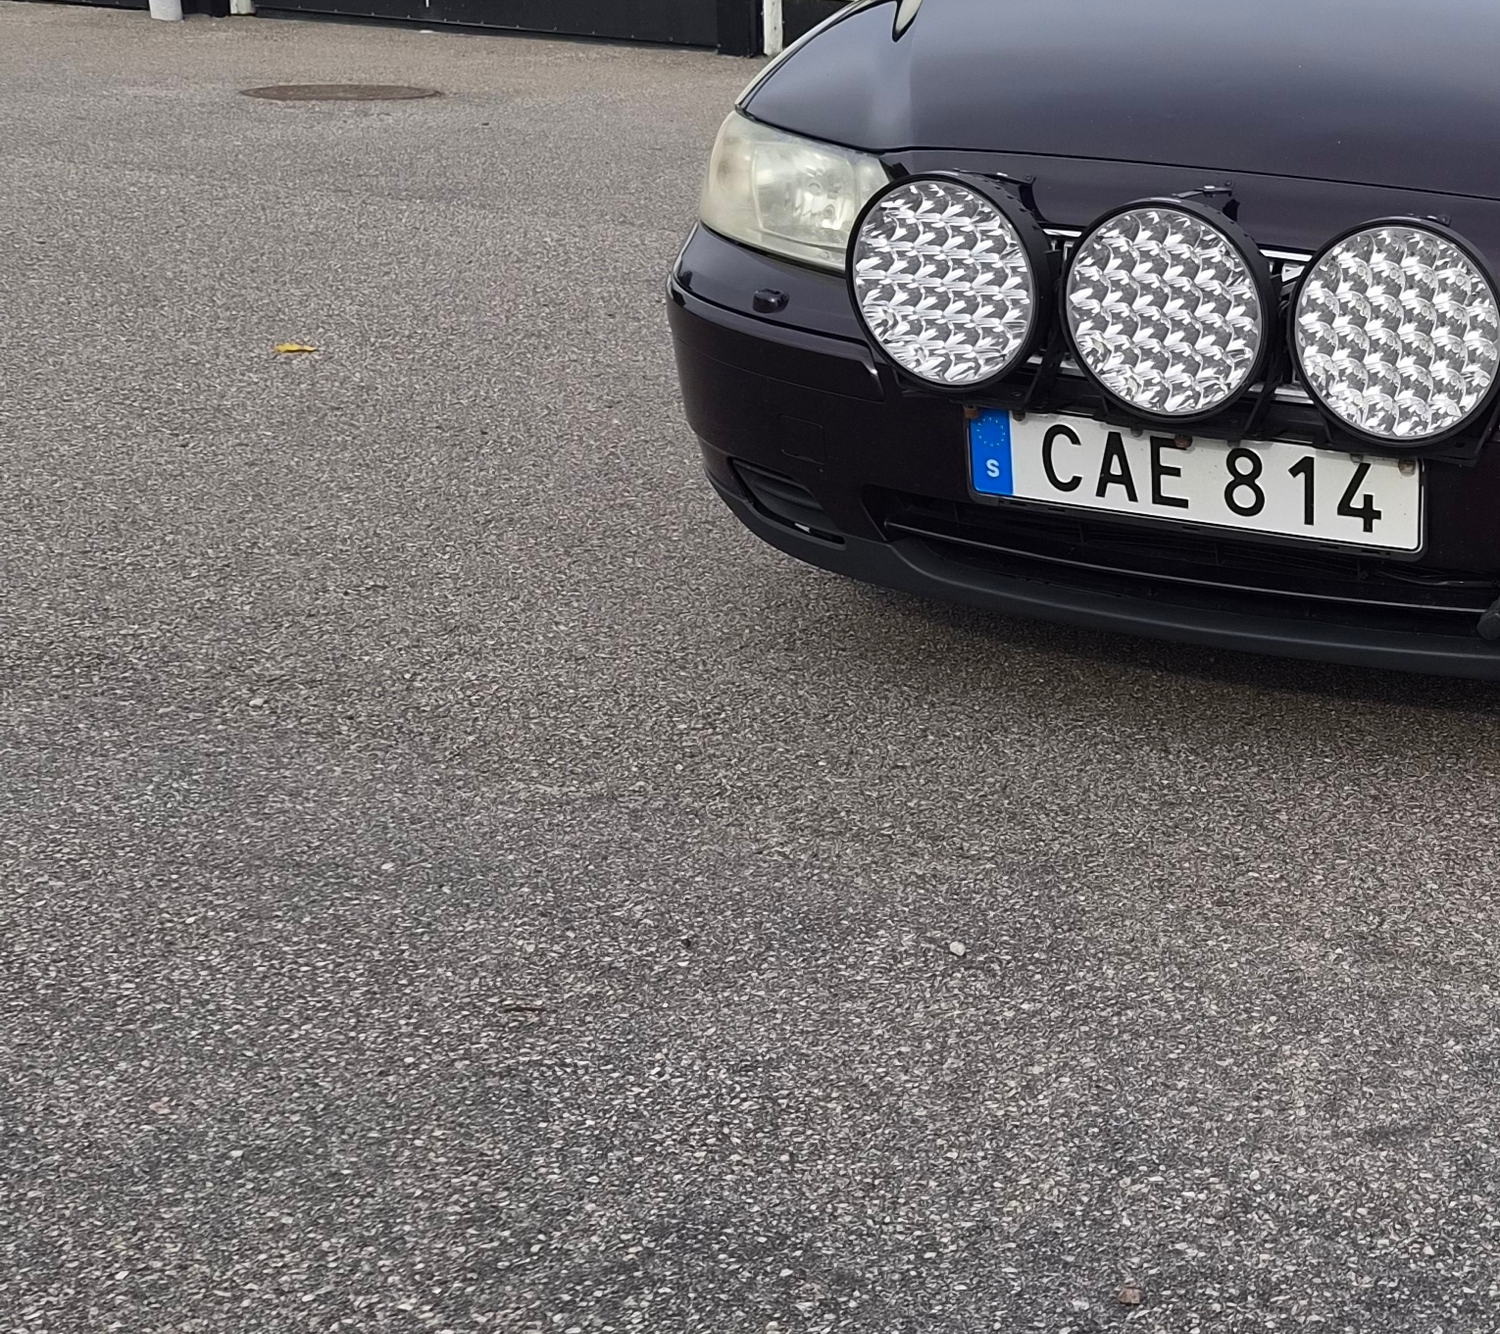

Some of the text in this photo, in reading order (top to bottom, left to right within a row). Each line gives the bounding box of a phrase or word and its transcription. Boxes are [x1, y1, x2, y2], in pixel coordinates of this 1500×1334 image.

[985, 458, 1000, 478] S
[1041, 423, 1383, 533] CAE 814
